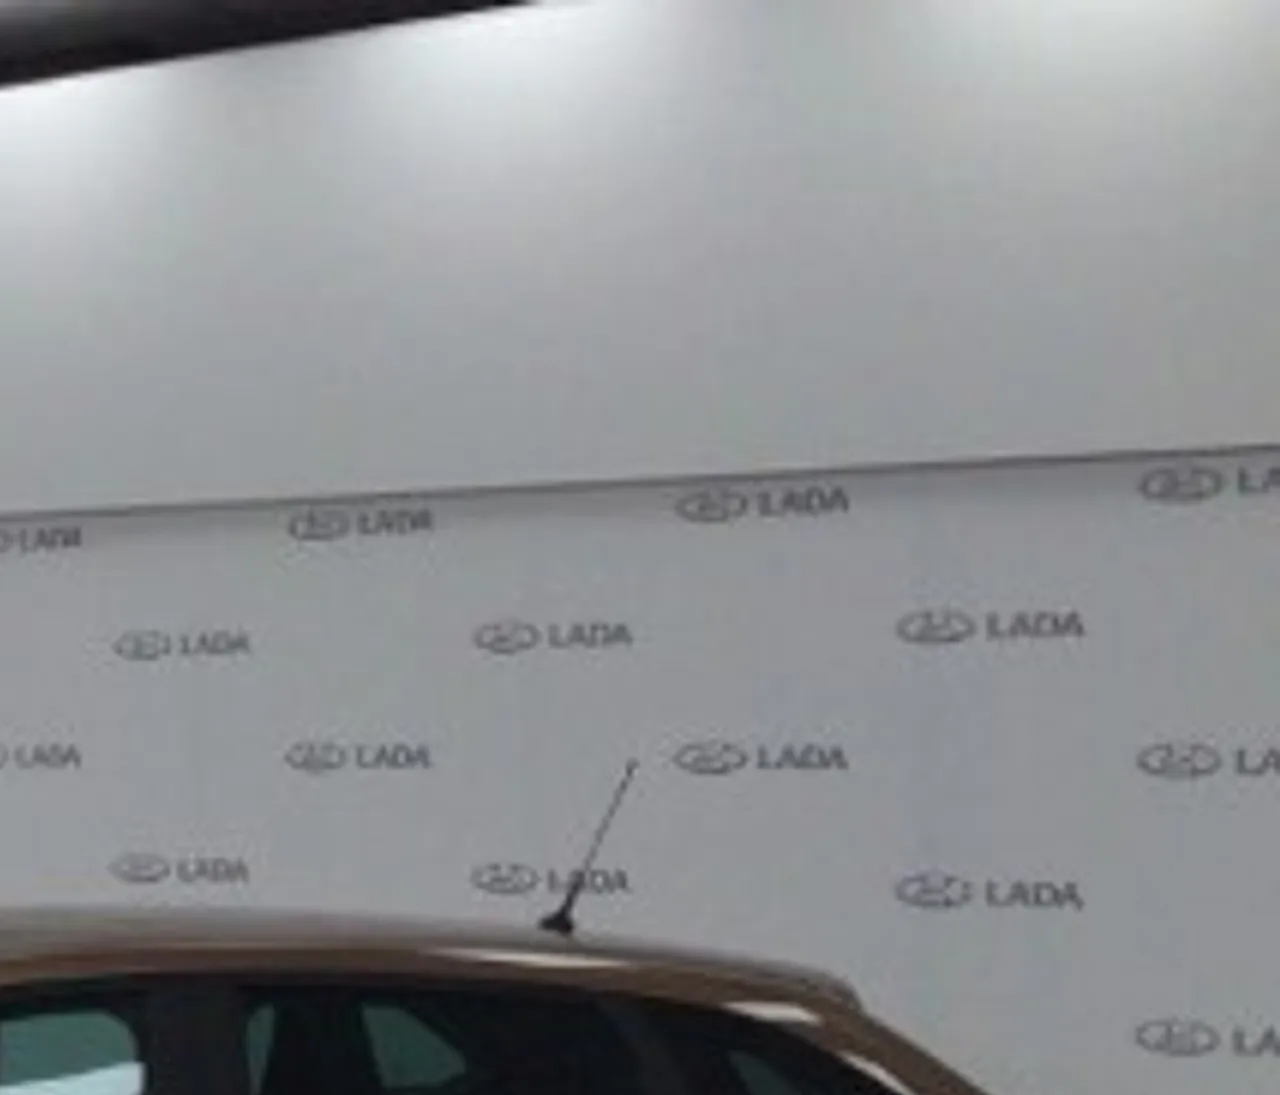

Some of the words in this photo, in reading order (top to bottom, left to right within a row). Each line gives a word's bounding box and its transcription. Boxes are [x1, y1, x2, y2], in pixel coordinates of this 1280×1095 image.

[756, 486, 849, 515] LADA
[356, 507, 435, 536] LADA
[548, 623, 634, 649] LADA
[986, 611, 1086, 640] LADA
[180, 632, 251, 656] LADA
[14, 744, 82, 769] LADA
[355, 744, 433, 770] LADA
[756, 744, 849, 771] LADA
[177, 857, 250, 883] LADA
[985, 881, 1085, 909] LADA
